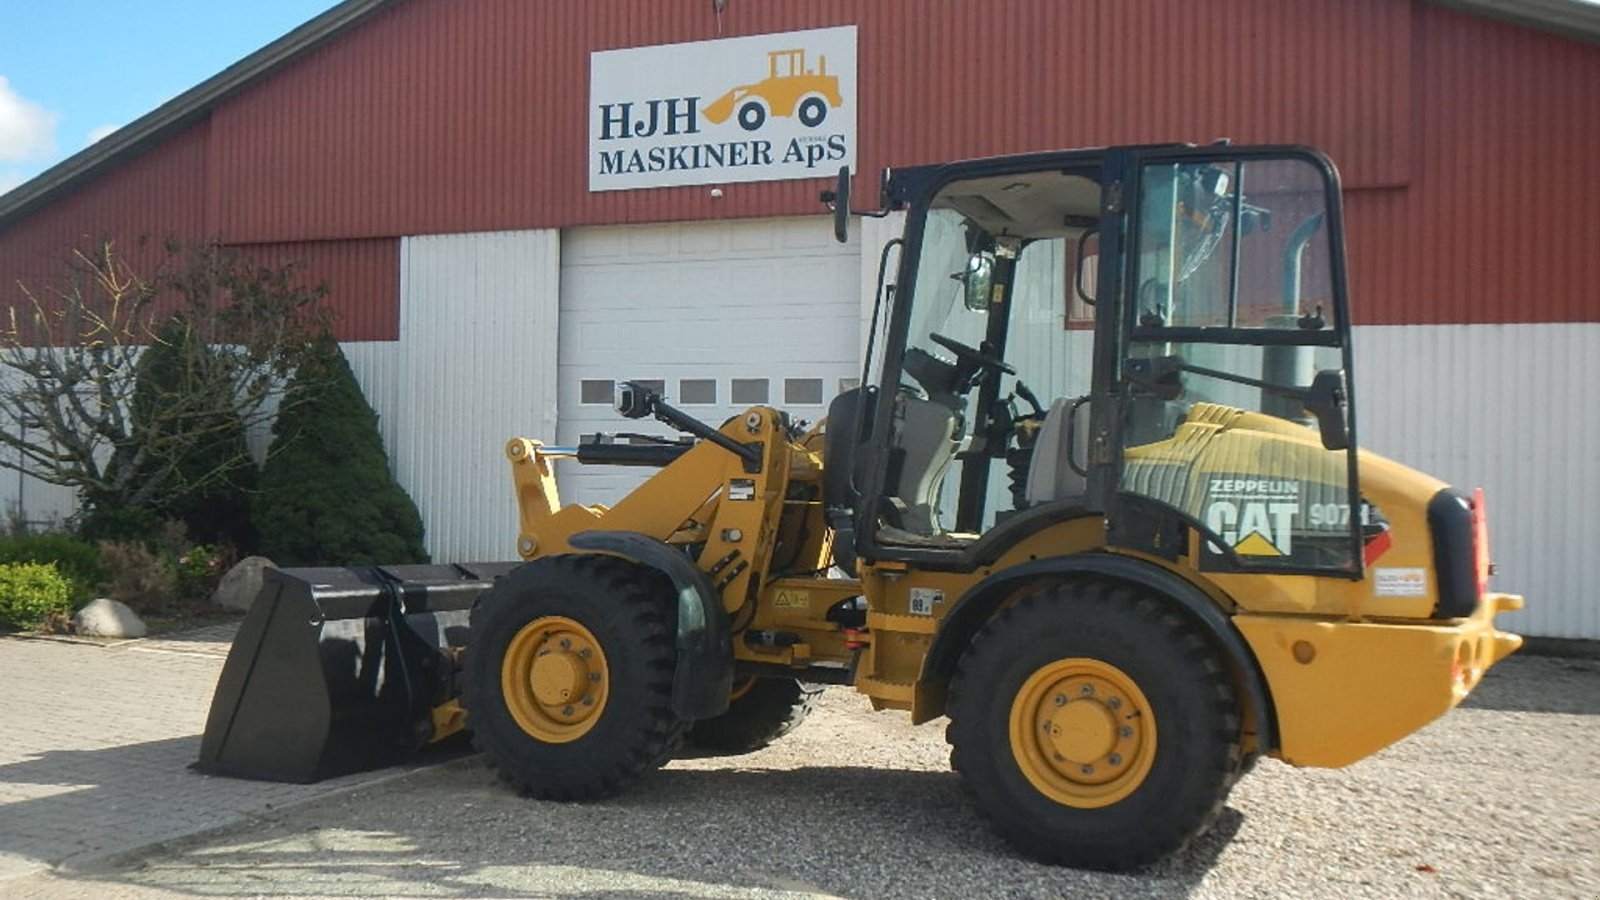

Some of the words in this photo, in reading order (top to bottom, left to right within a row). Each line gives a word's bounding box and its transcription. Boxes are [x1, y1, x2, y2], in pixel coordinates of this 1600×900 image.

[598, 96, 701, 140] HJH
[598, 140, 773, 175] MASKINER
[782, 134, 846, 168] ApS
[1210, 479, 1299, 493] ZEPPELIN
[1206, 501, 1299, 556] CAT
